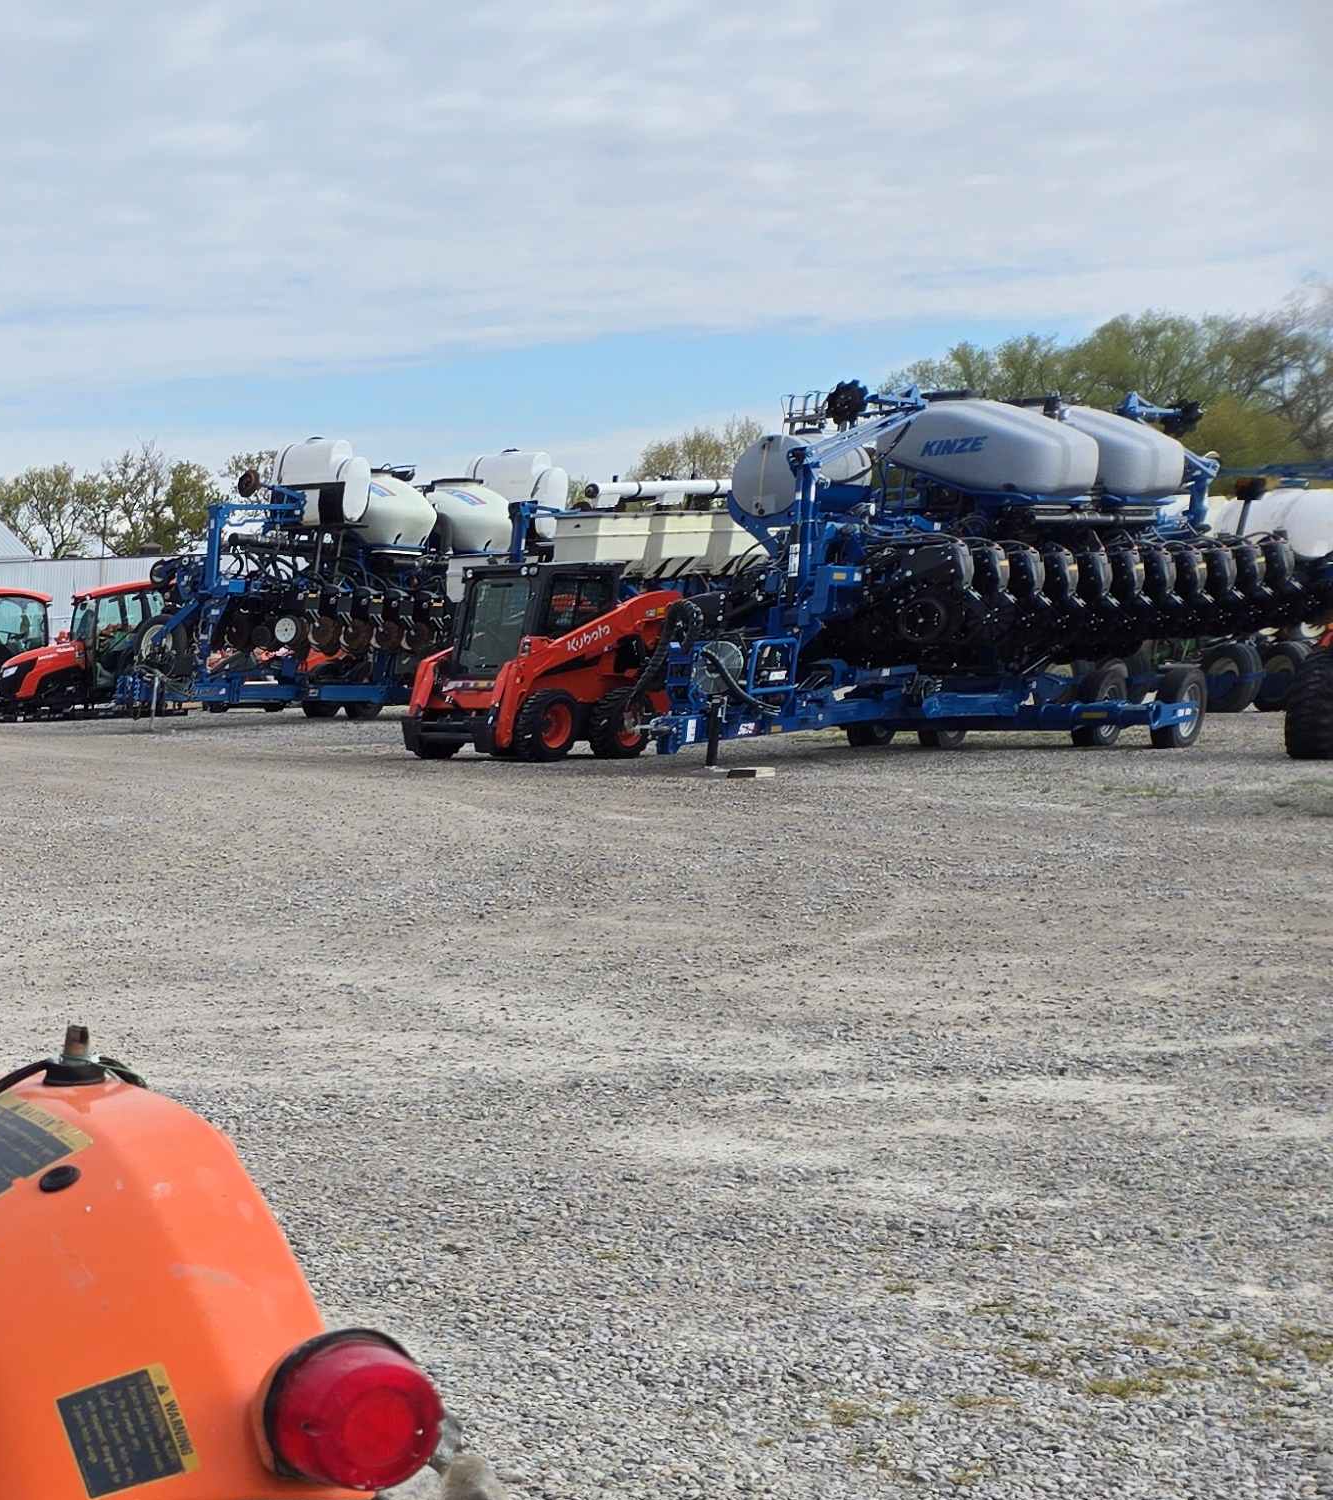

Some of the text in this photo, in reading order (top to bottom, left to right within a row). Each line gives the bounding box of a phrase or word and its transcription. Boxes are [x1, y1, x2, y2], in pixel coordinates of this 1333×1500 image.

[920, 435, 989, 457] KINZE
[566, 623, 611, 652] Kubota
[164, 1399, 194, 1456] WARNING
